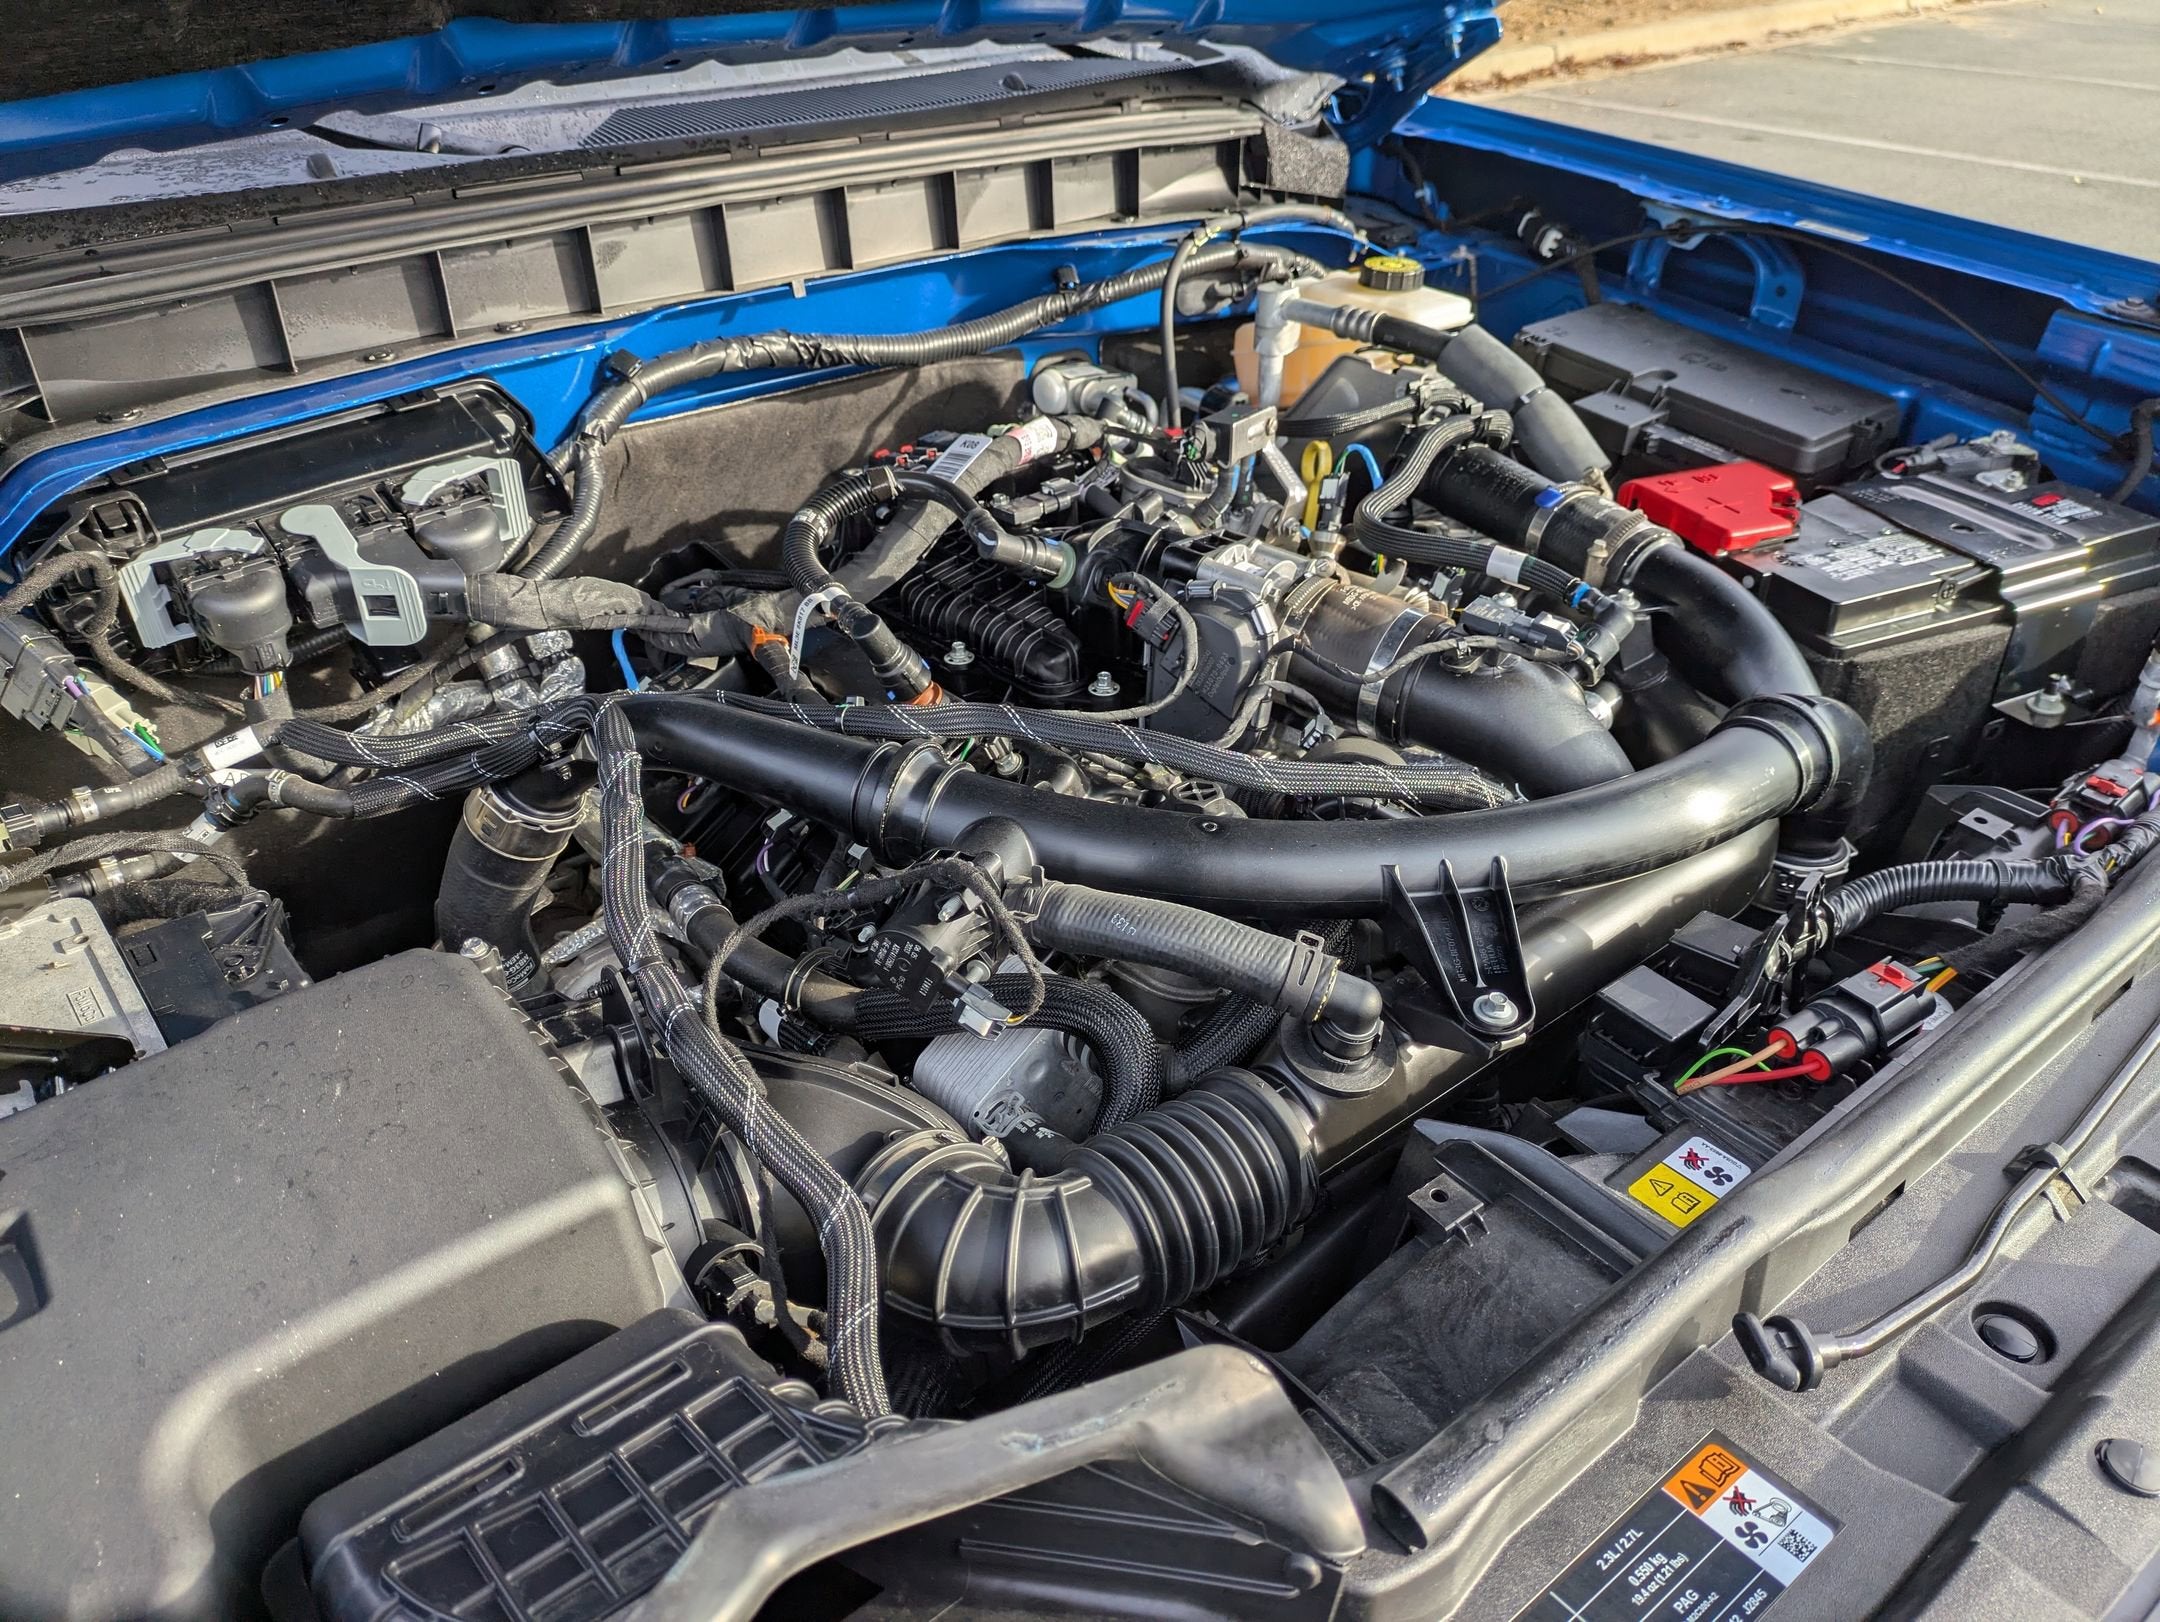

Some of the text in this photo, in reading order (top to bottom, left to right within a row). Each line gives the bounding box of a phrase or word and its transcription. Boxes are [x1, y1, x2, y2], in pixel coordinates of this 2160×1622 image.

[507, 961, 533, 984] FoMoCo
[75, 989, 98, 1021] FoMoCo
[1596, 1528, 1644, 1571] 2.3L / 2.7L
[1627, 1552, 1668, 1587] 0.550 kg
[1631, 1588, 1650, 1606] 19.4
[1647, 1581, 1660, 1593] oz
[1668, 1552, 1690, 1569] lbs)
[1672, 1589, 1700, 1615] PAG
[1741, 1587, 1768, 1615] J2845
